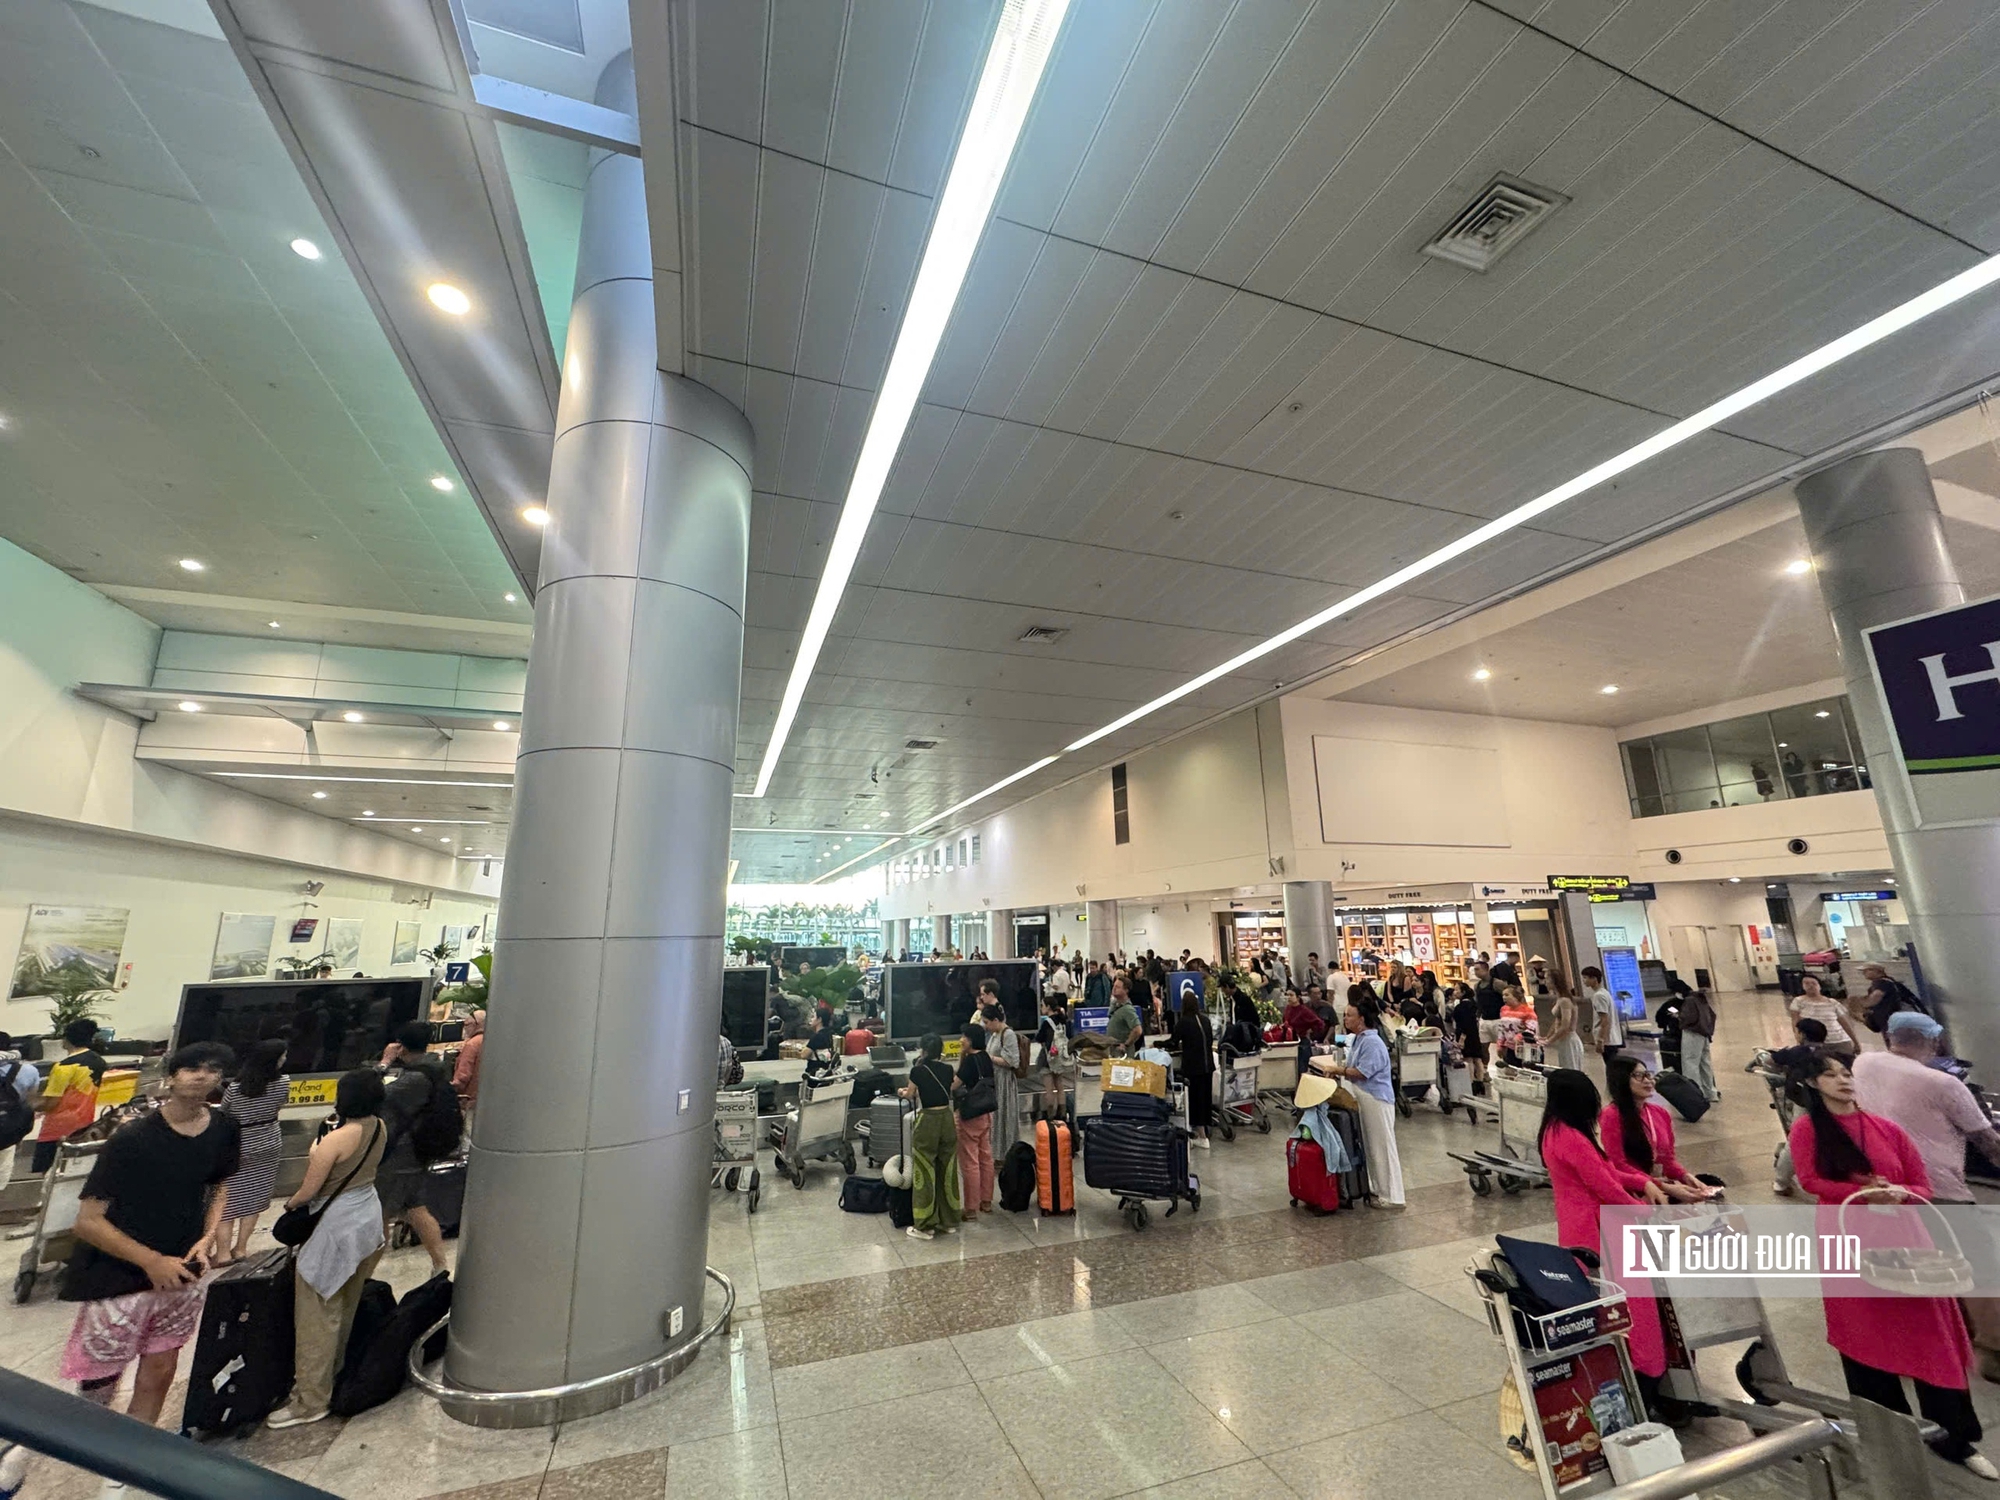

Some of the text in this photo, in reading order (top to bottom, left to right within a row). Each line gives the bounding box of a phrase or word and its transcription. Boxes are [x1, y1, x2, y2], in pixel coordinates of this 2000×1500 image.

[1918, 640, 2000, 722] H
[911, 954, 920, 963] 7
[452, 966, 463, 980] 7
[1180, 979, 1199, 1000] 6
[1556, 1316, 1596, 1337] seamaster
[1535, 1362, 1571, 1382] seamaster
